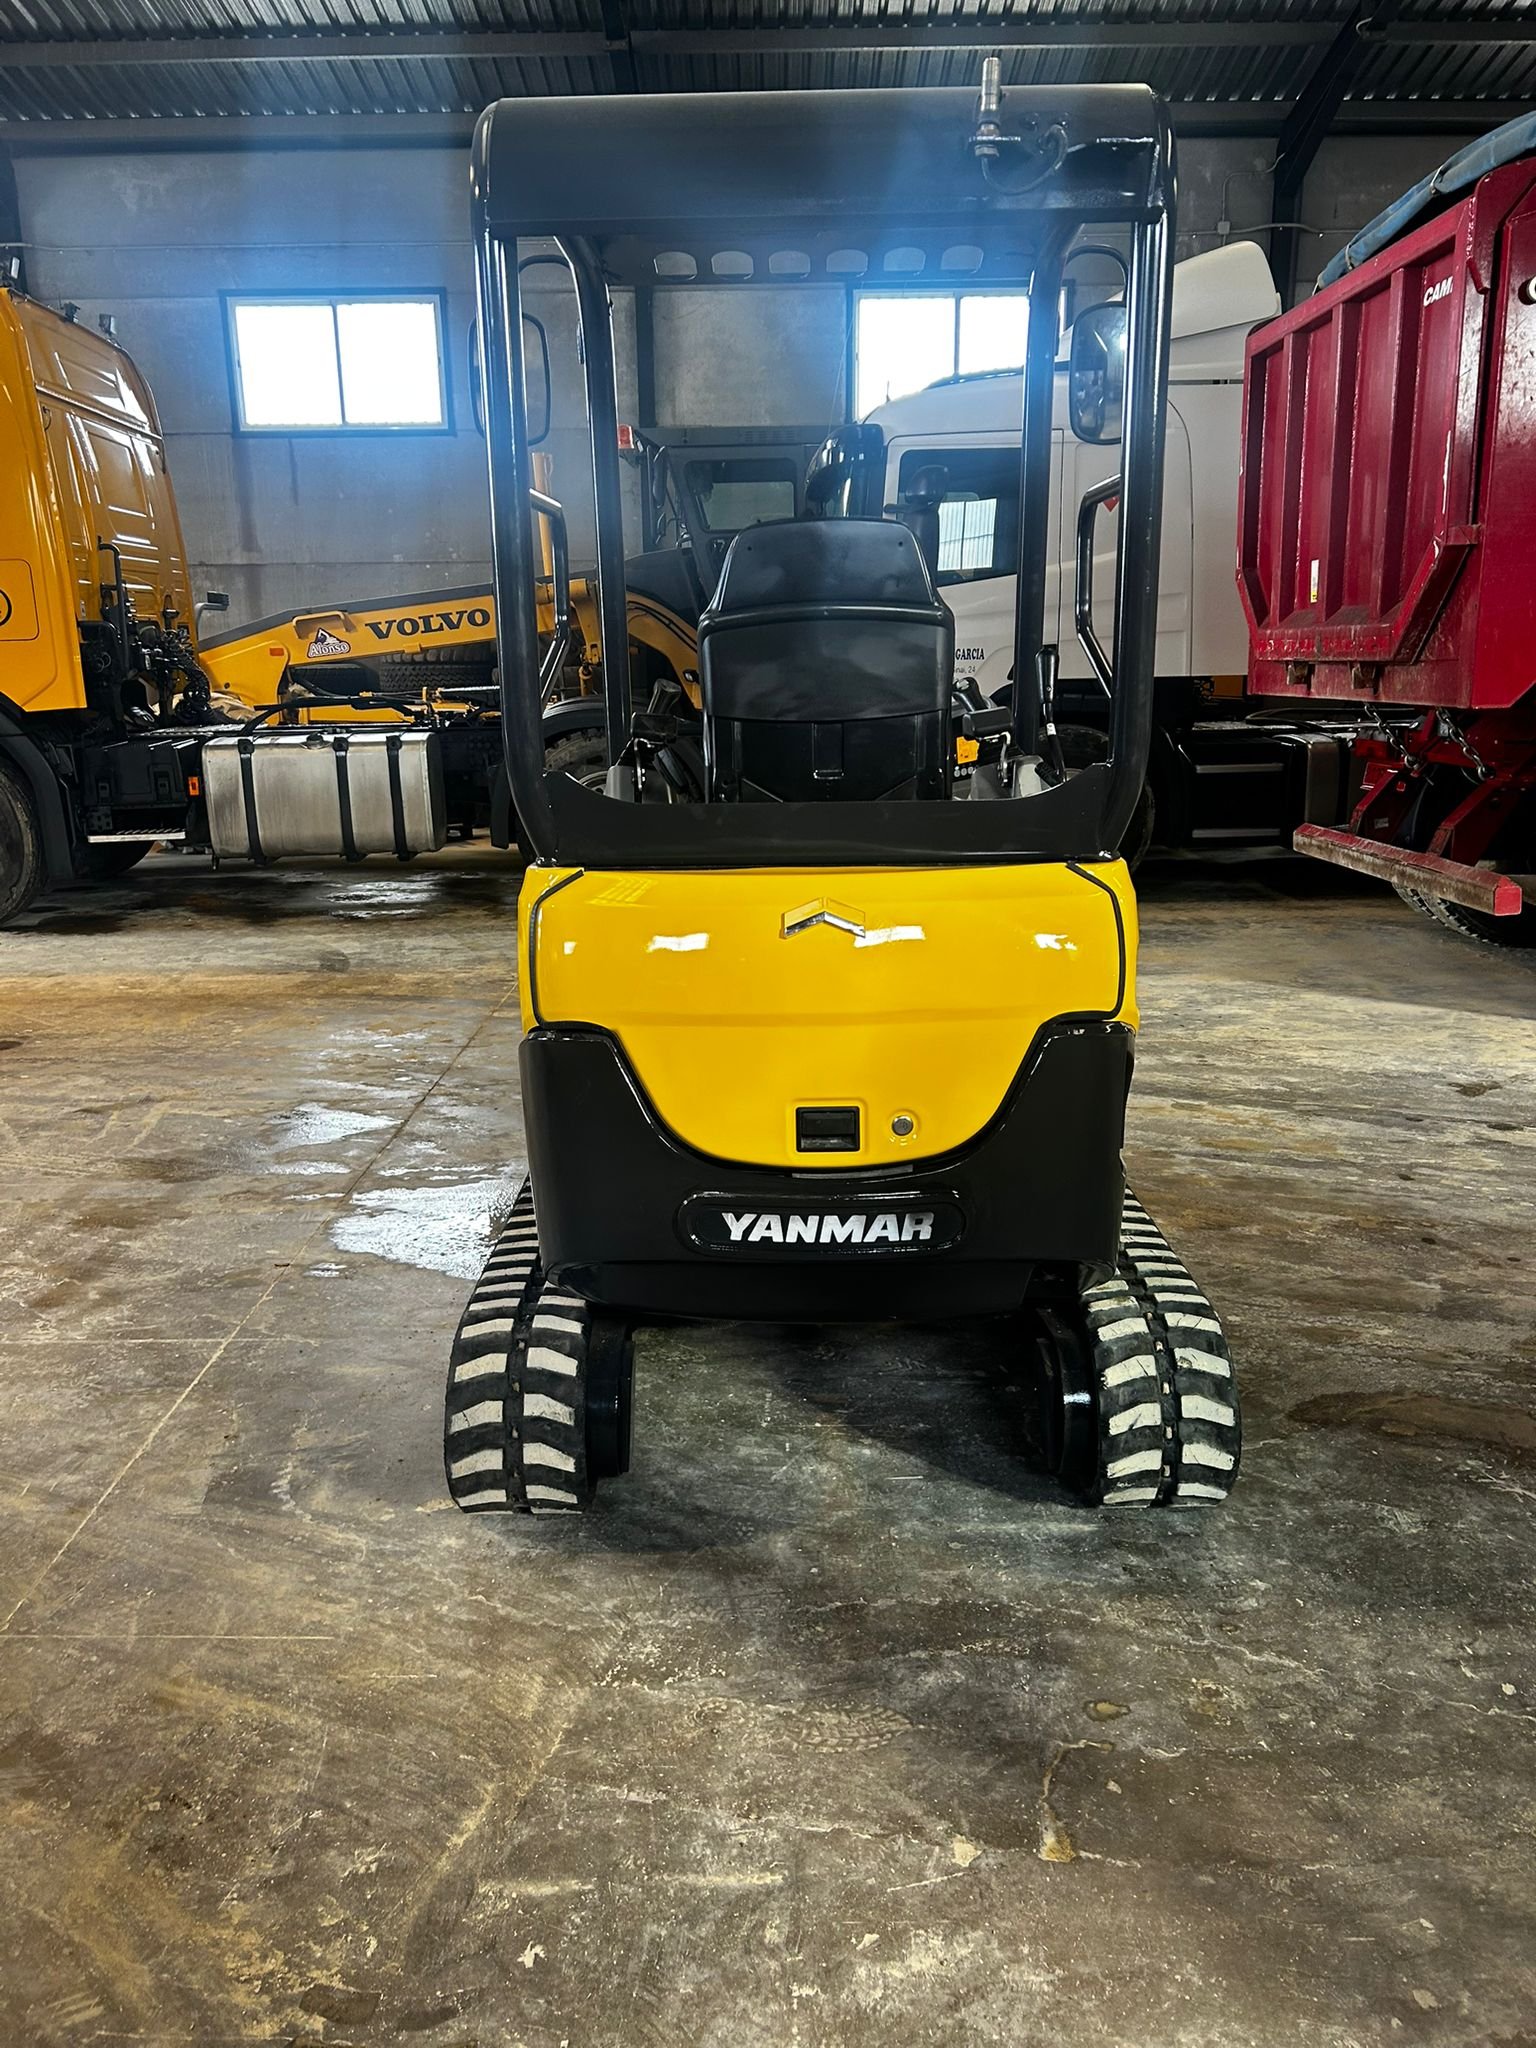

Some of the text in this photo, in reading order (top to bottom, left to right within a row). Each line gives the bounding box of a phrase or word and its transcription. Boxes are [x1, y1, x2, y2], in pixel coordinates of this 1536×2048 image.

[1423, 275, 1453, 307] CAM
[365, 608, 491, 640] VOLVO
[308, 642, 349, 657] Alonso
[955, 648, 985, 660] GARCIA
[721, 1212, 935, 1243] YANMAR
